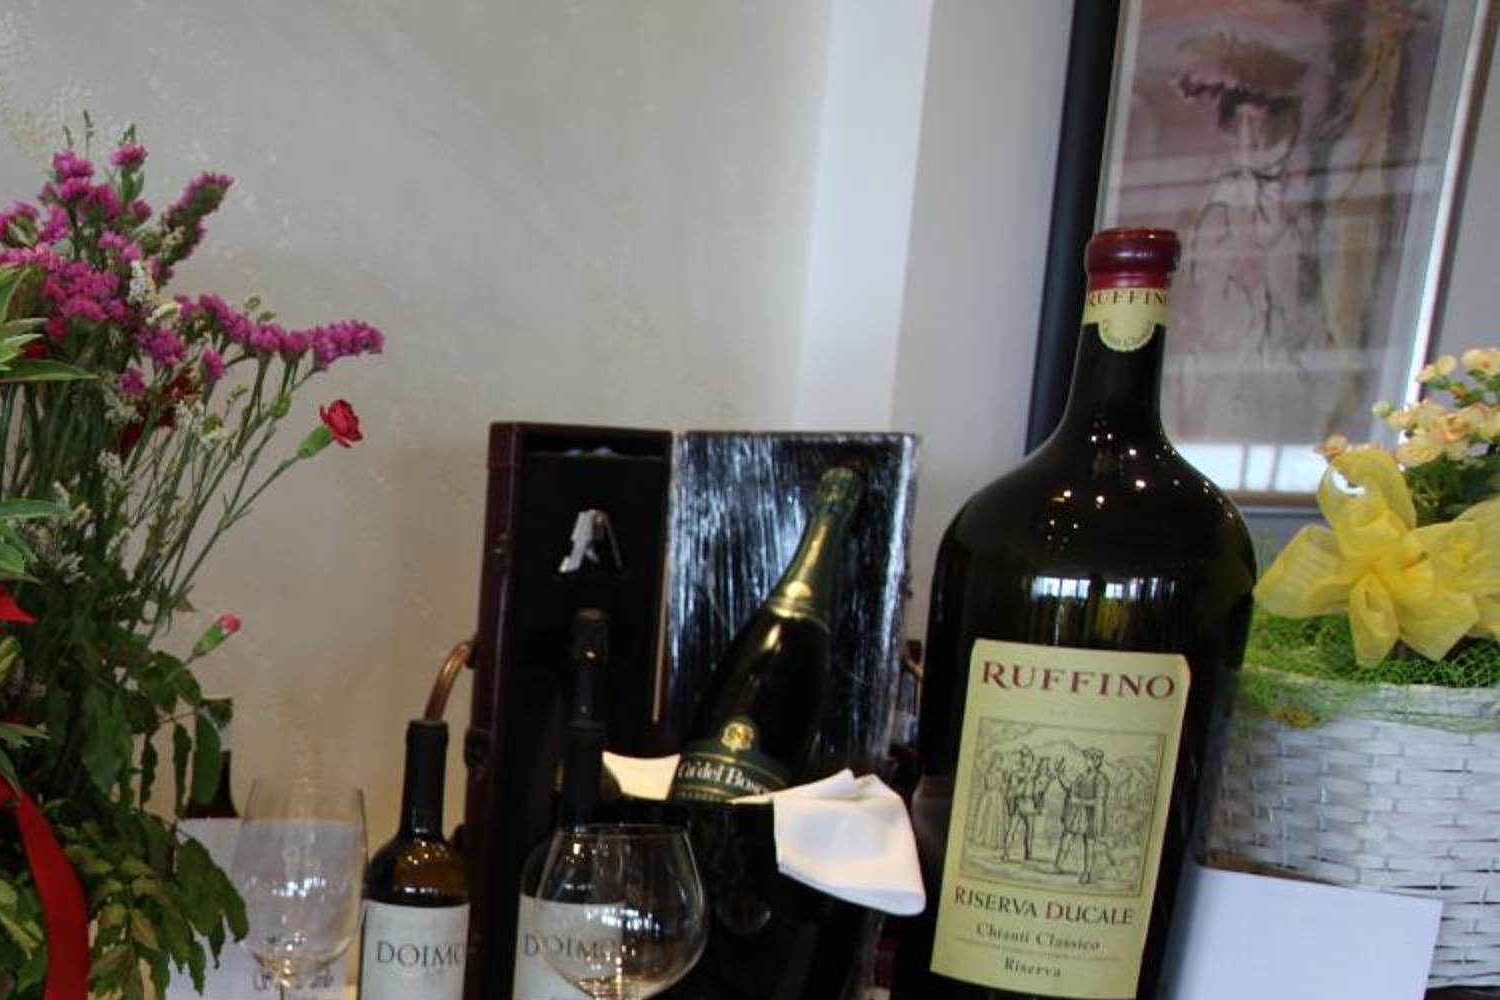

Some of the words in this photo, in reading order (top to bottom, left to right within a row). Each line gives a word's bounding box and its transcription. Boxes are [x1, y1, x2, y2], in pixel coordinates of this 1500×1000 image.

[980, 660, 1176, 700] RUFFINO
[954, 884, 1038, 919] RISERVA
[1045, 900, 1135, 926] DUCALE
[976, 922, 1030, 945] Chianti
[1035, 931, 1101, 952] Classico
[1004, 956, 1062, 978] Riserva
